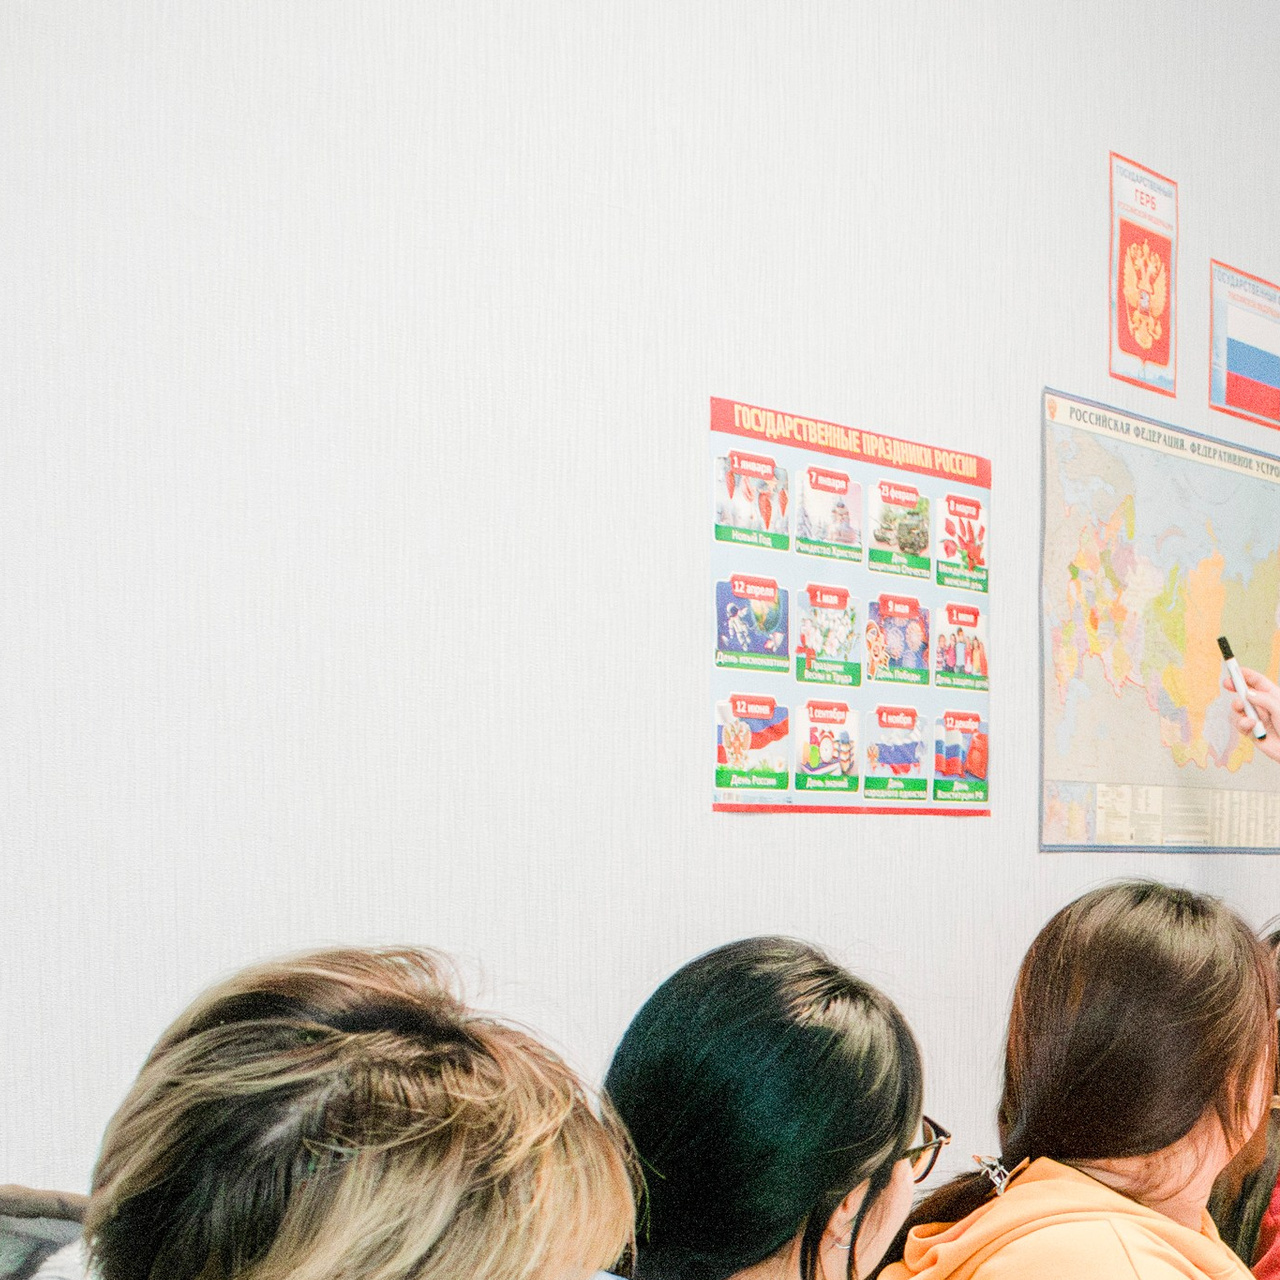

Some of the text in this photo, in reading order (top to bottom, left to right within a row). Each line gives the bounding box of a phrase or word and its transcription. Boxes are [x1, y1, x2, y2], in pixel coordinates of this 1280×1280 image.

[1135, 188, 1156, 211] ГЕРБ
[734, 404, 978, 478] ГОСУДАРСТВЕННЫЕ ПРАЗДНИКИ РОССИИ
[1069, 406, 1131, 436] РОССИЙСКАЯ
[1190, 438, 1253, 470] ФЕДЕРАТИВНОЕ
[733, 455, 739, 469] 1
[734, 581, 775, 597] 12 апреля
[736, 701, 746, 713] 12
